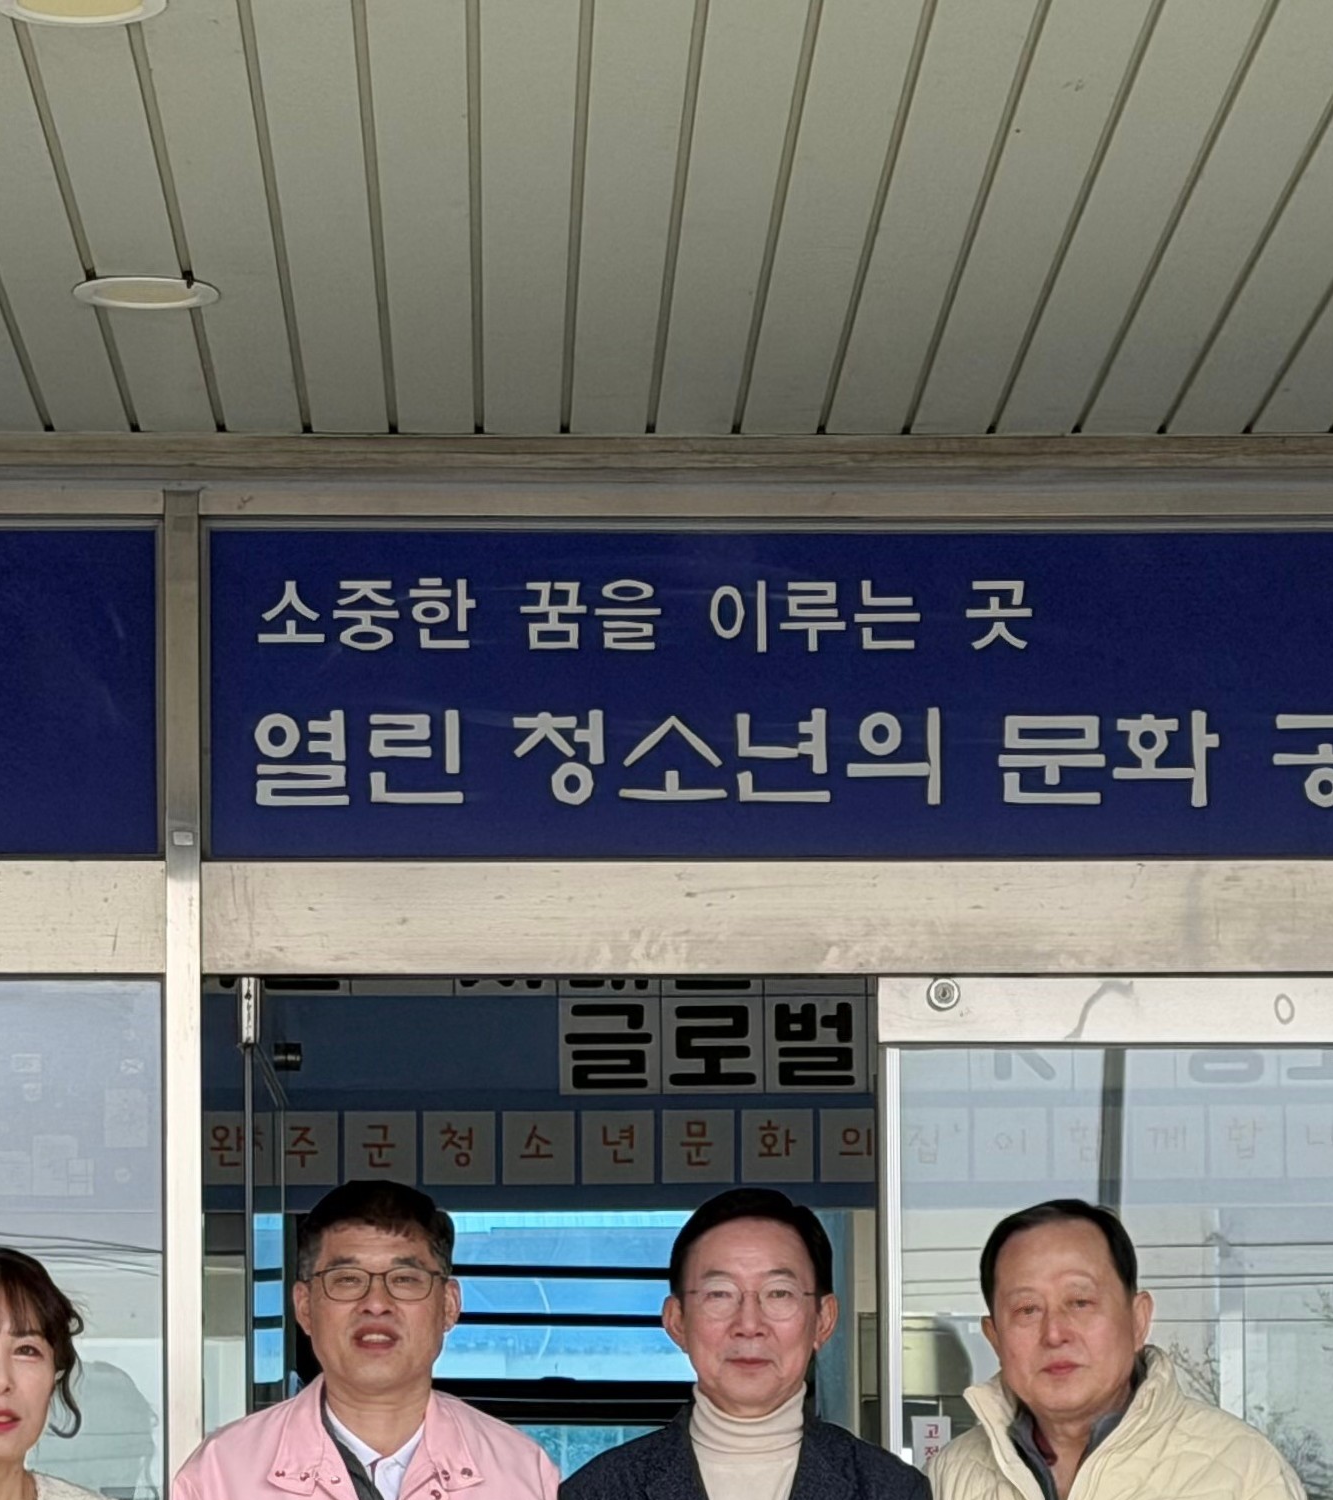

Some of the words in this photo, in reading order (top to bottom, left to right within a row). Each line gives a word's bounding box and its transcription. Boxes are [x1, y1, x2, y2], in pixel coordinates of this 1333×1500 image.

[257, 577, 476, 652] 소중한
[519, 577, 663, 652] 꿈을
[709, 580, 922, 652] 이루는
[963, 578, 1035, 652] 곳
[253, 707, 466, 808] 열린
[511, 706, 944, 807] 청소년의
[997, 708, 1221, 808] 문화
[564, 1001, 857, 1090] 글로벌
